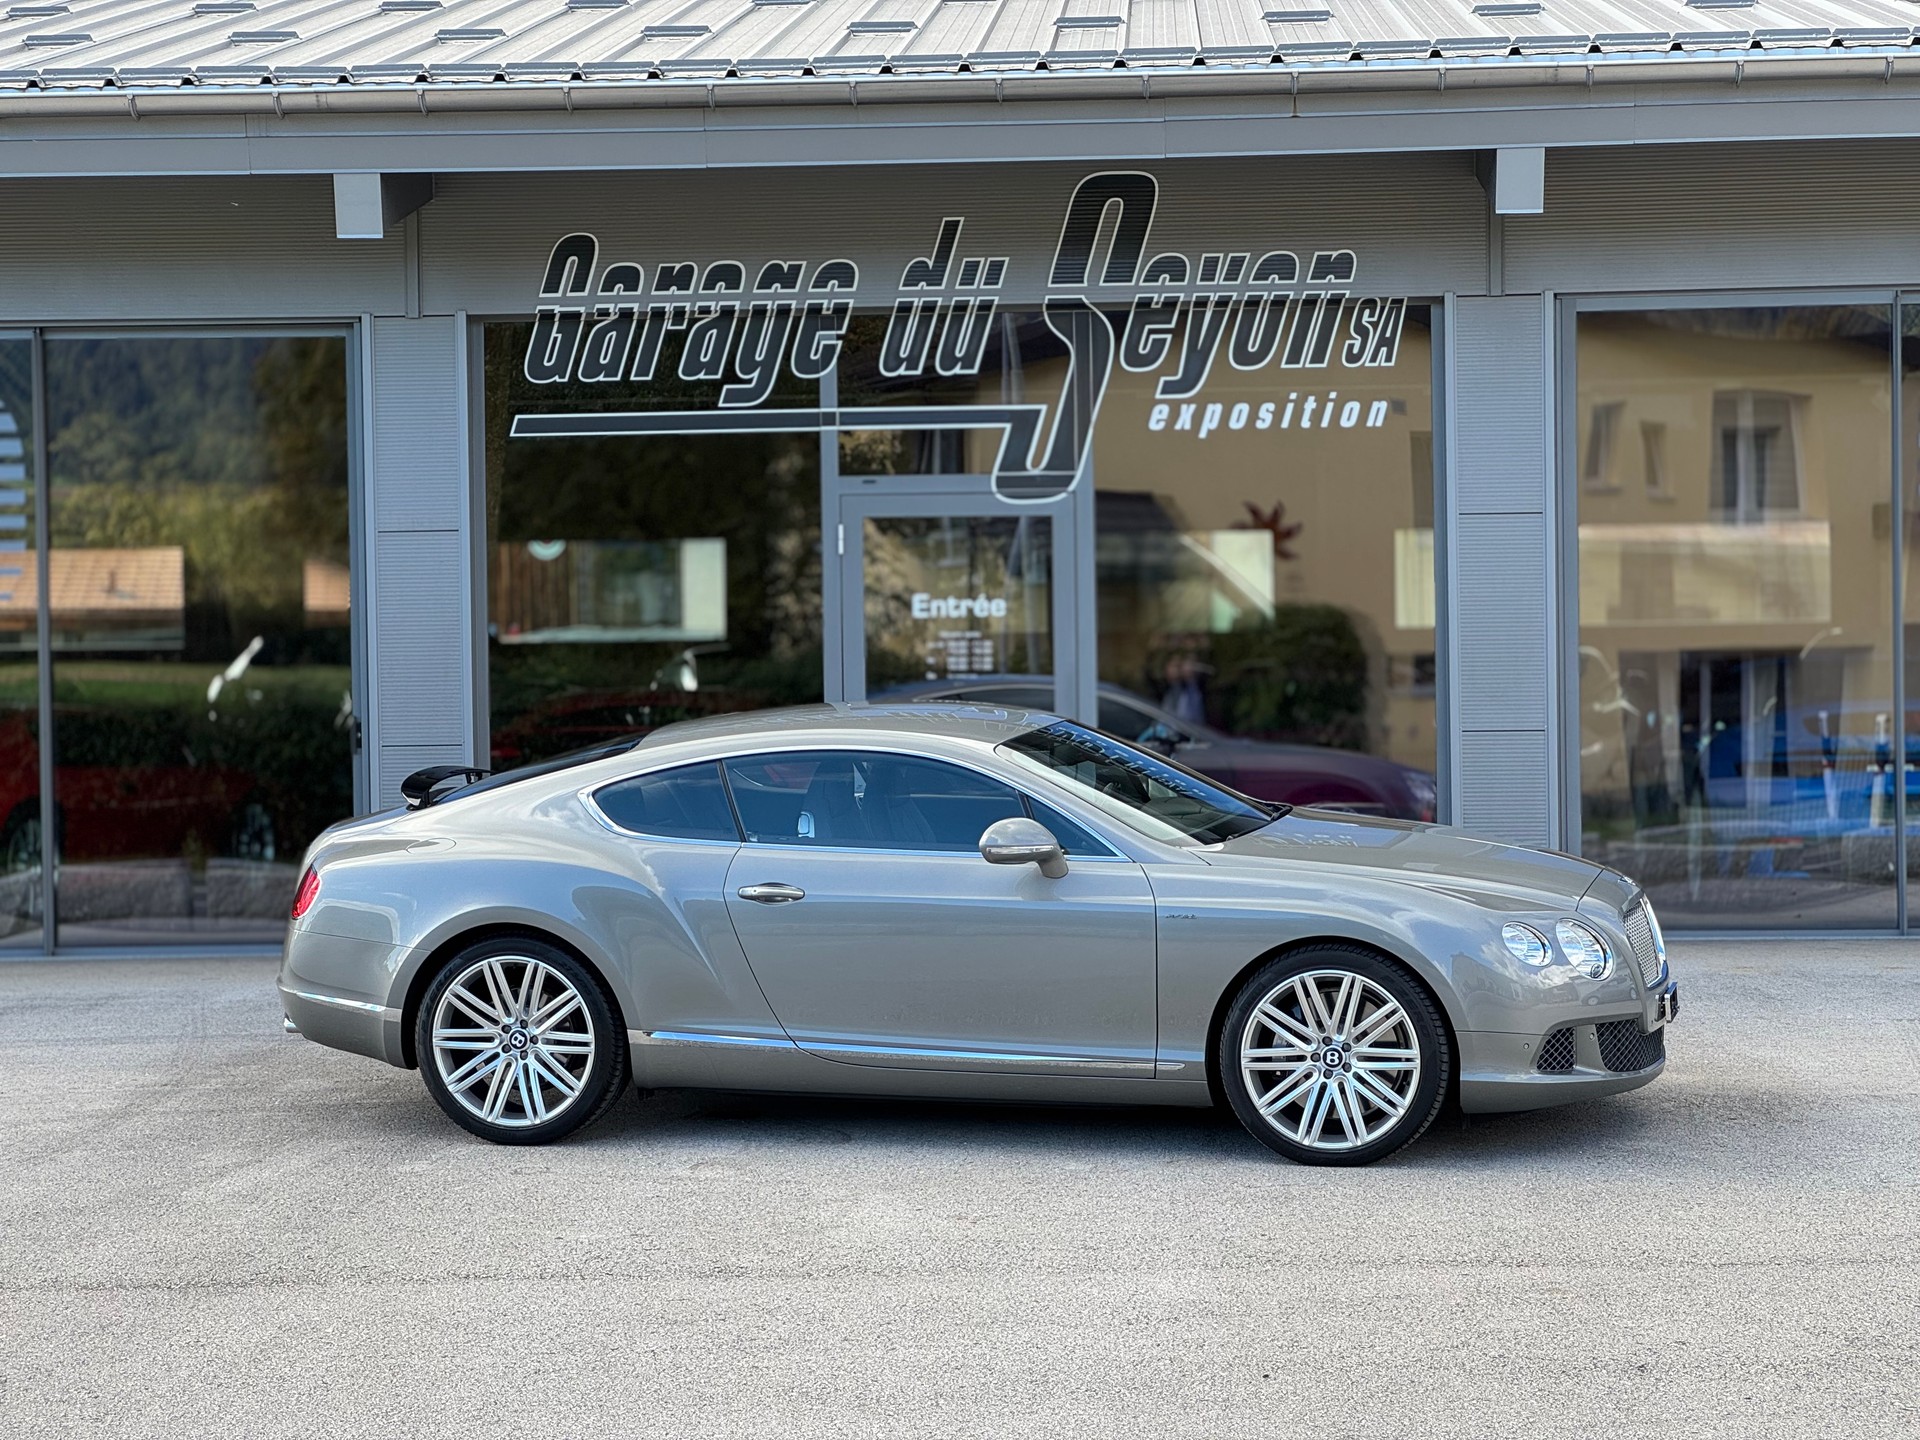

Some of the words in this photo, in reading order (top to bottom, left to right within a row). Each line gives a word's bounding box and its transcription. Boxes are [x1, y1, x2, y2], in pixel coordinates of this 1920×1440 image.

[524, 232, 859, 407] Garage
[879, 217, 1009, 376] du
[991, 170, 1357, 504] Seyon
[1342, 296, 1407, 367] SA
[1148, 391, 1388, 438] exposition
[911, 592, 1007, 619] Entrée
[1326, 1051, 1339, 1065] B
